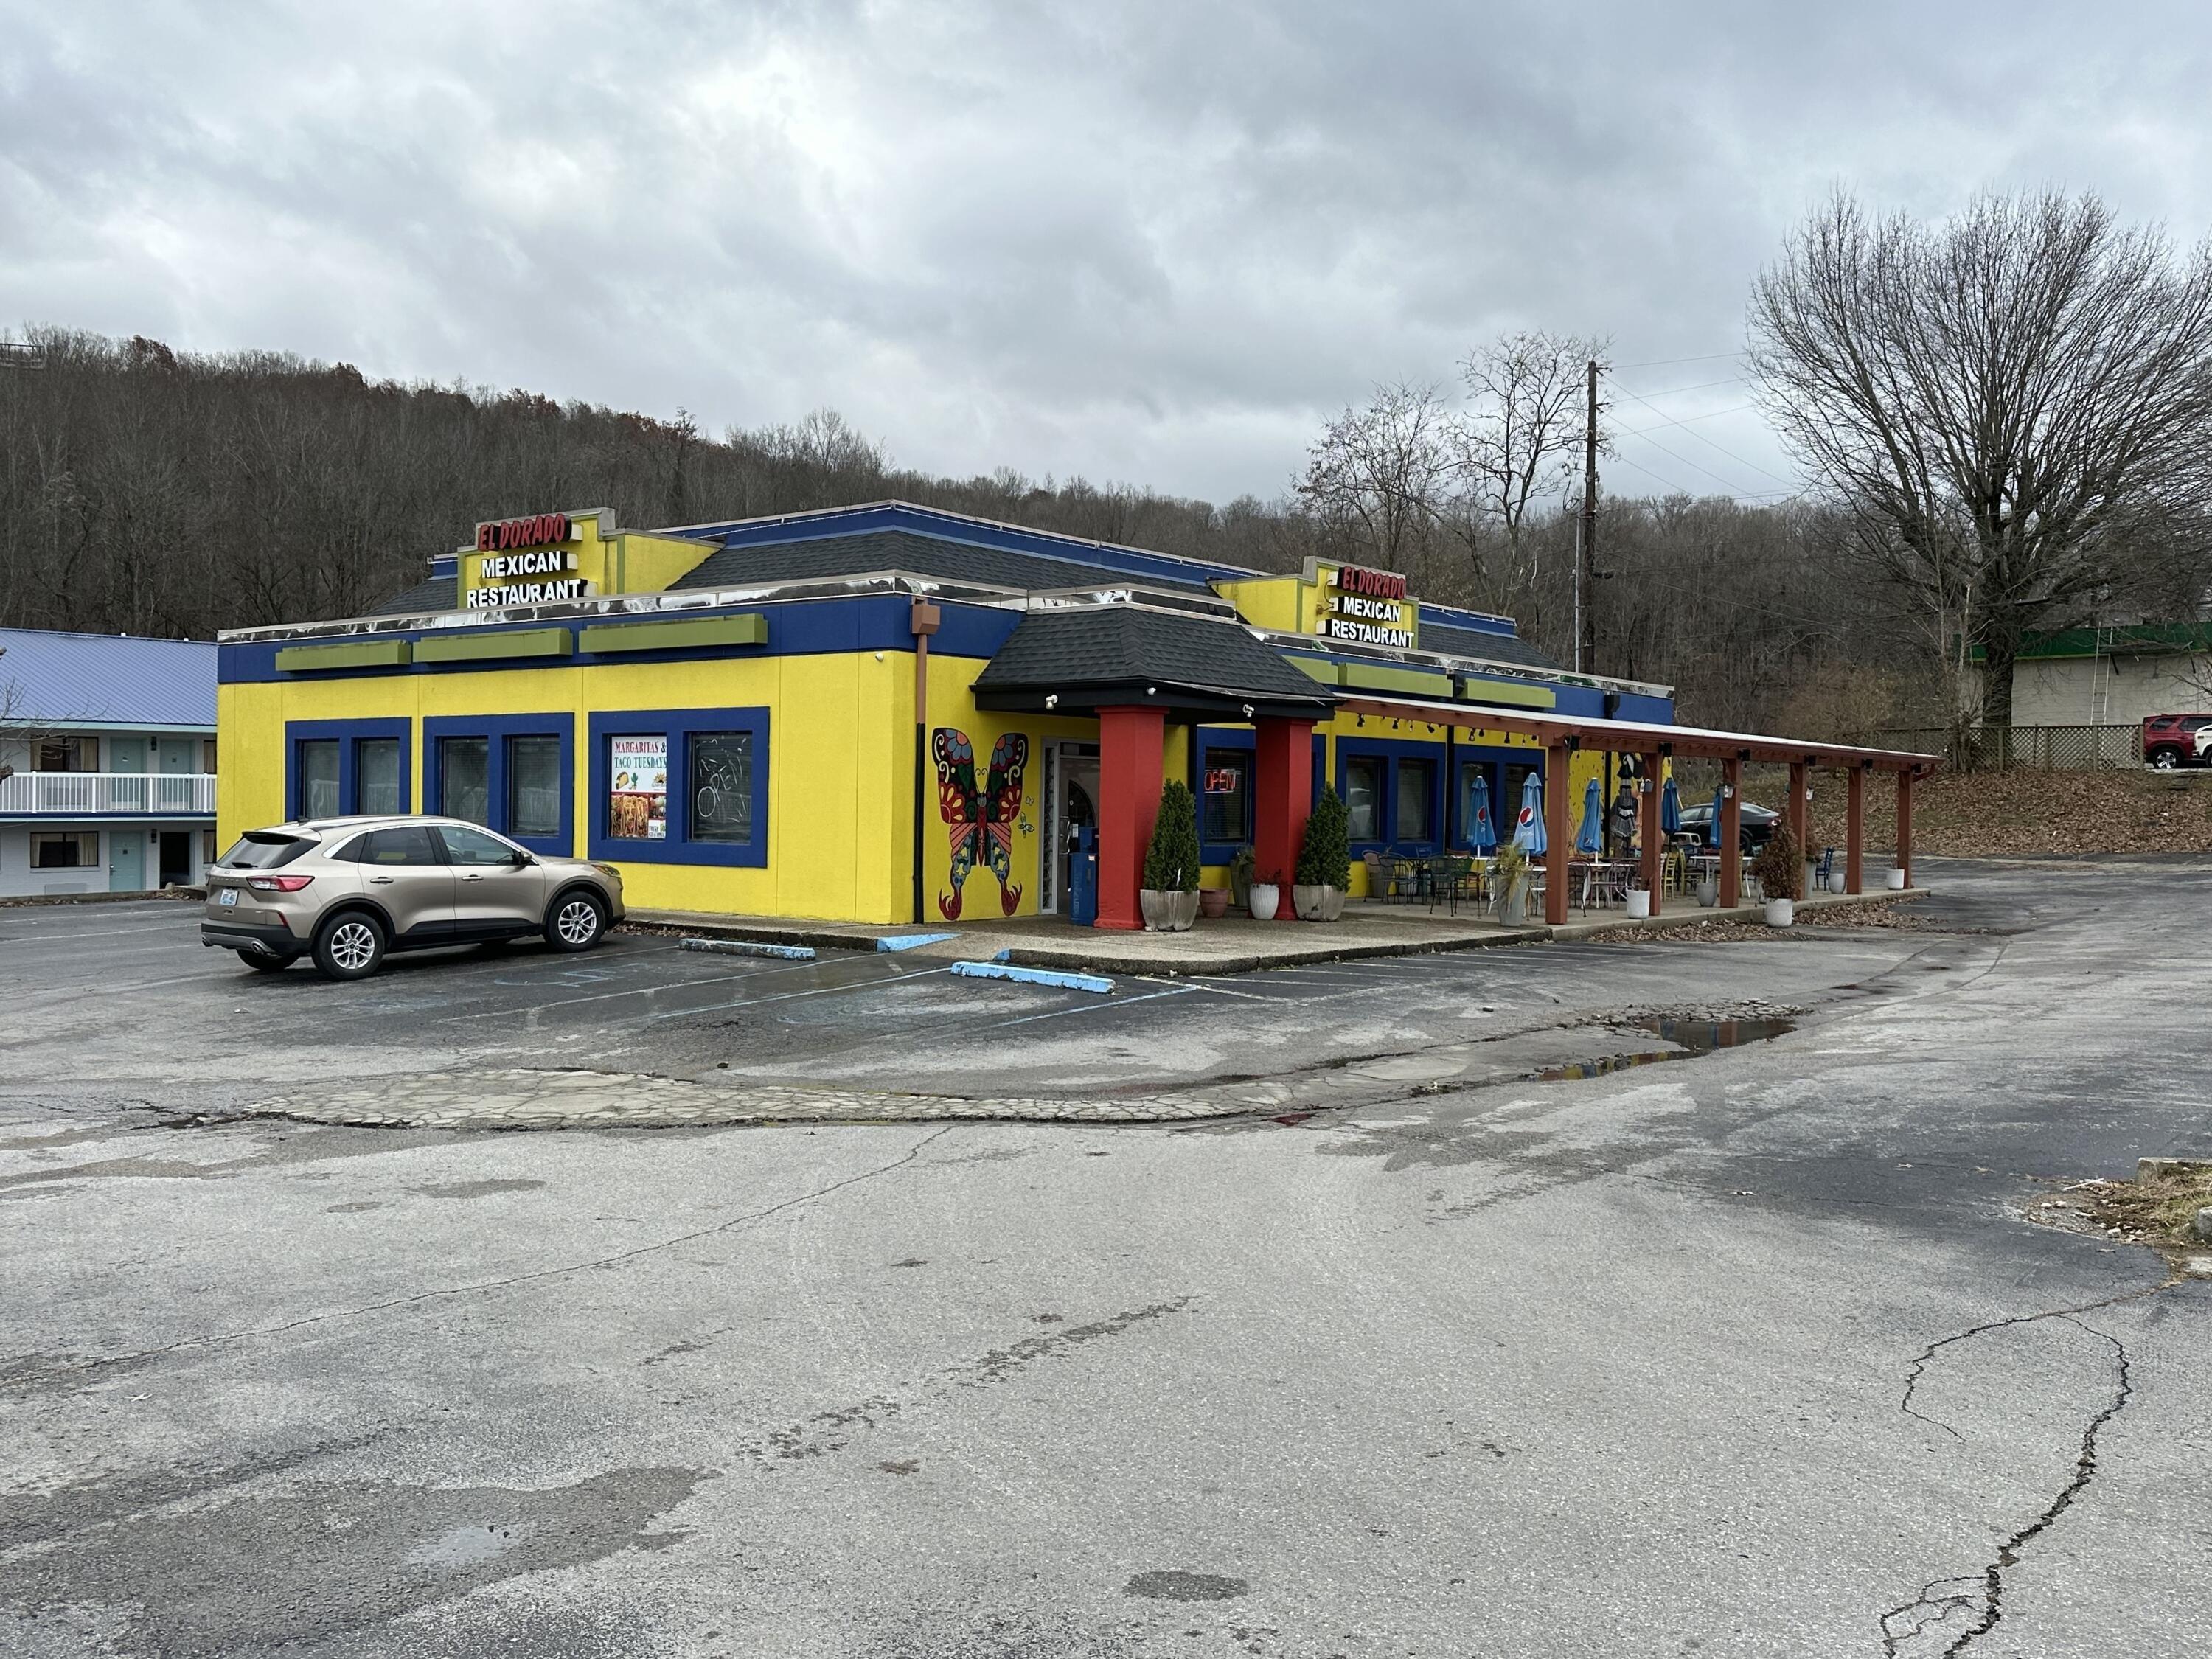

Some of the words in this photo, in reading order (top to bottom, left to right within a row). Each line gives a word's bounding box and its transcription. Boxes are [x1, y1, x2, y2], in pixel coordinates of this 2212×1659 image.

[479, 524, 495, 552] EL
[499, 513, 566, 549] DORADO
[481, 551, 561, 578] MEXICAN
[467, 579, 581, 608] RESTAURANT
[1342, 566, 1356, 591] EL
[1357, 569, 1407, 601] DORADO
[1343, 597, 1401, 622] MEXICAN
[1331, 619, 1414, 648] RESTAURANT
[614, 741, 659, 754] MARGARITAS
[661, 742, 667, 754] &
[614, 757, 631, 769] TACO
[634, 757, 667, 769] TUESDAYS
[697, 757, 742, 818] OPEN
[1204, 771, 1236, 790] OPEN
